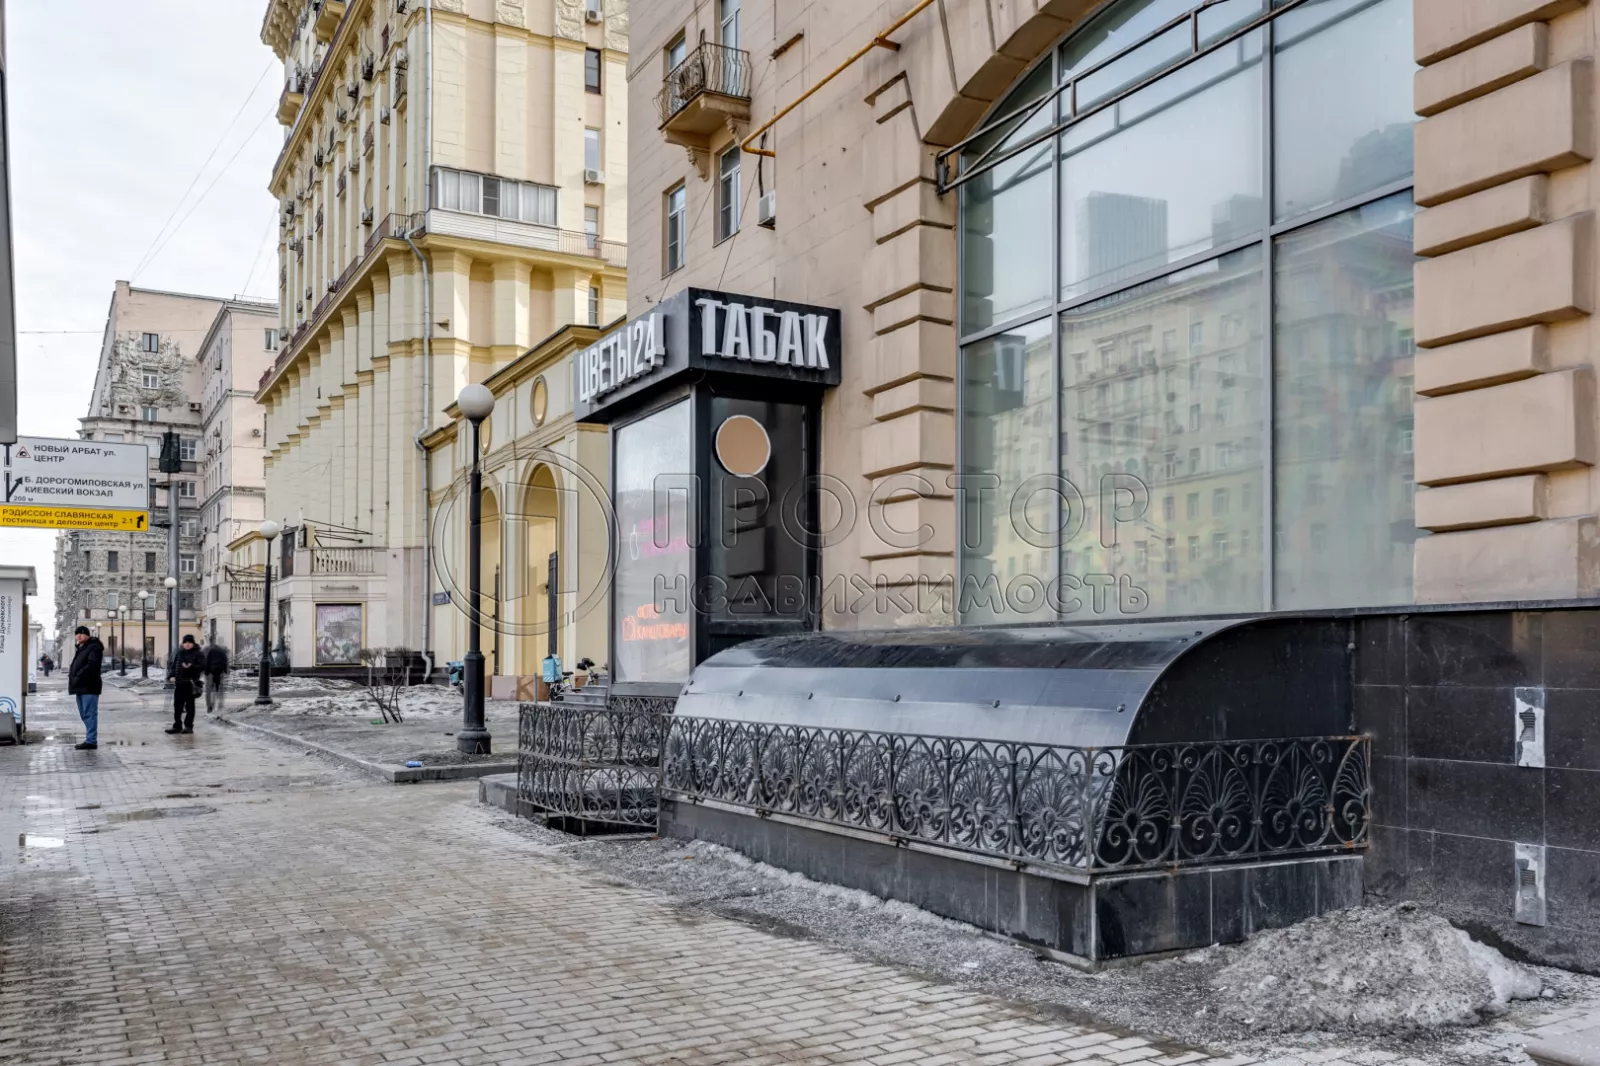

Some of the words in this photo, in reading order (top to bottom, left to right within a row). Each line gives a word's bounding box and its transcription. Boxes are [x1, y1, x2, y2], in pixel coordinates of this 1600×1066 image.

[695, 298, 829, 370] ТАБАК
[34, 444, 69, 453] НОВЫЙ
[71, 447, 101, 455] АРБАТ
[34, 455, 65, 463] ЦЕНТР
[36, 477, 131, 488] ДОРОГОМИЛОВСКАЯ
[25, 486, 74, 496] КИЕВСКИЙ
[76, 488, 113, 497] ВОКЗАЛ
[2, 508, 53, 517] РЭДИССОН
[54, 511, 114, 520] СЛАВЯНСКАЯ
